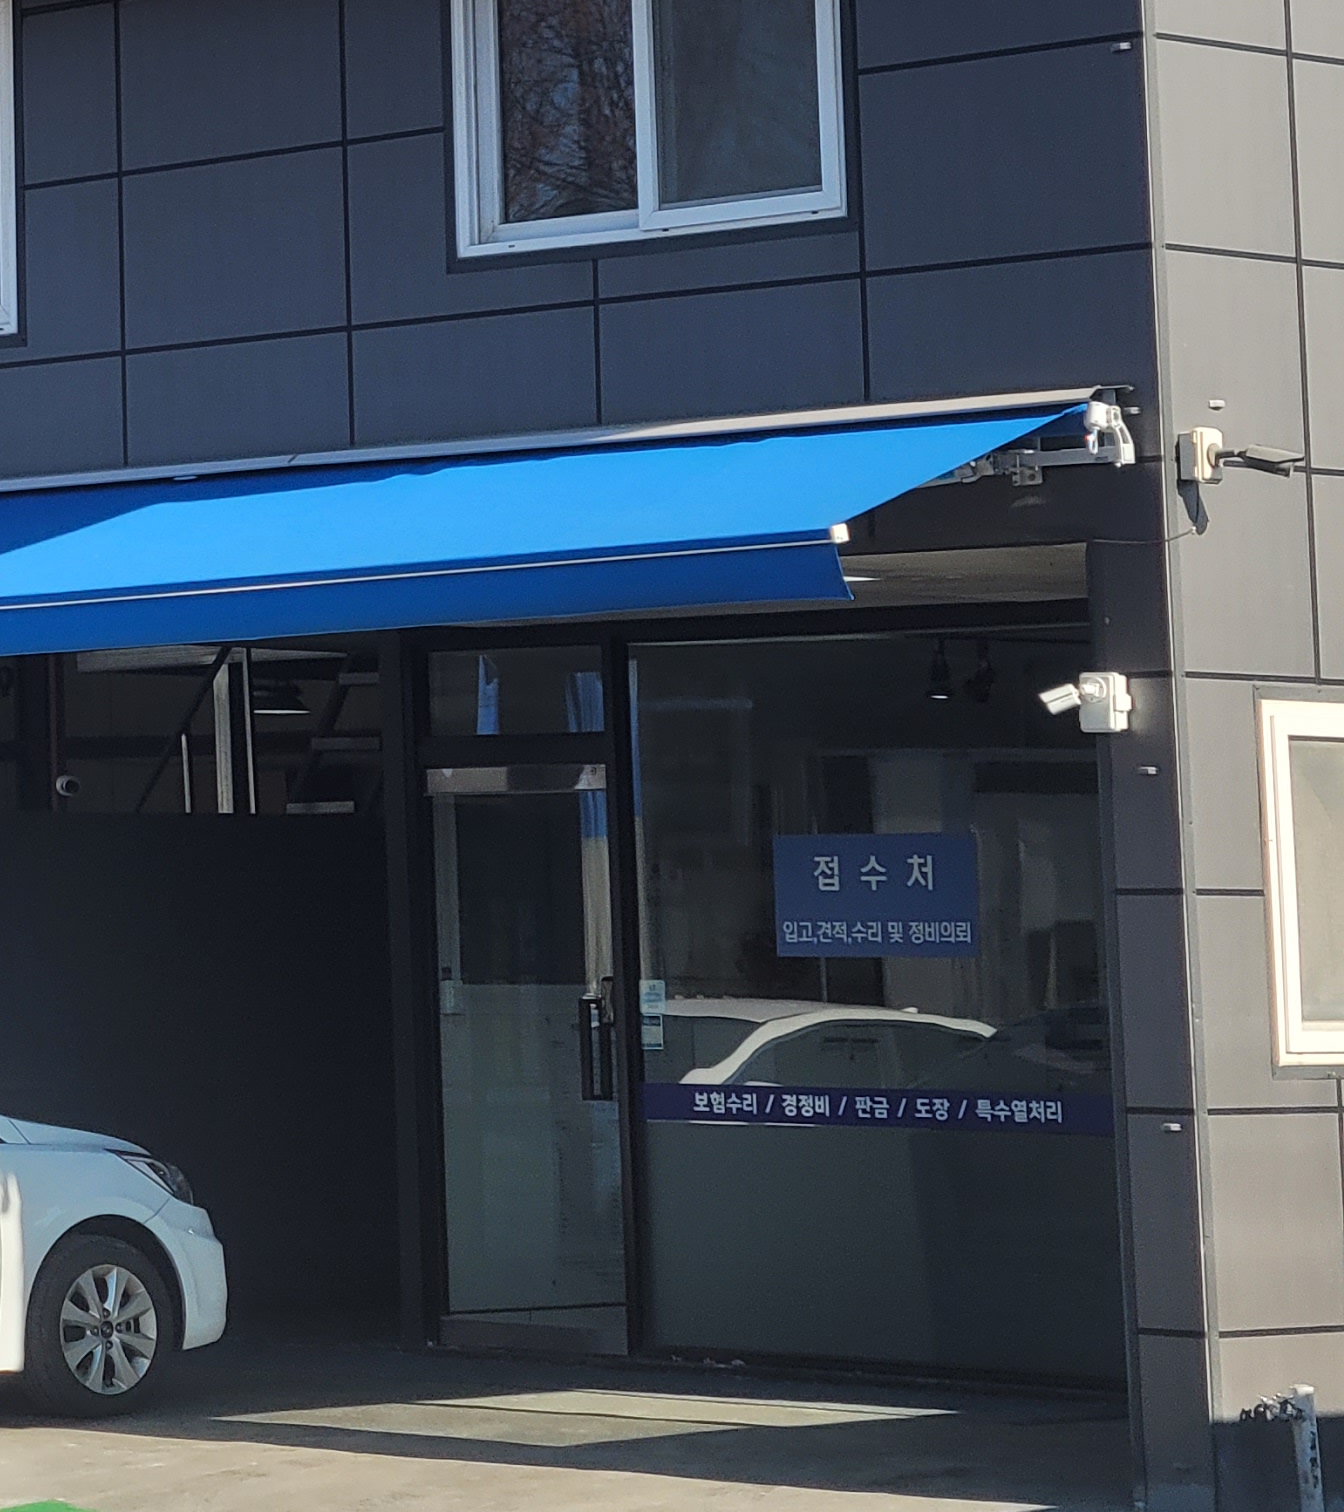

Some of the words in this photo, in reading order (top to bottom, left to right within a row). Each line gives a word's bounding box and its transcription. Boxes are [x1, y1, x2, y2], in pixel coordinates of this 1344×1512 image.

[814, 855, 932, 890] 접수처
[783, 922, 881, 943] 입고,견적,수리
[888, 922, 903, 942] 및
[909, 922, 971, 943] 정비의뢰
[694, 1092, 756, 1114] 보험수리
[782, 1095, 829, 1116] 경정비
[855, 1097, 889, 1118] 판금
[915, 1099, 950, 1120] 도장
[976, 1100, 1062, 1123] 특수열처리
